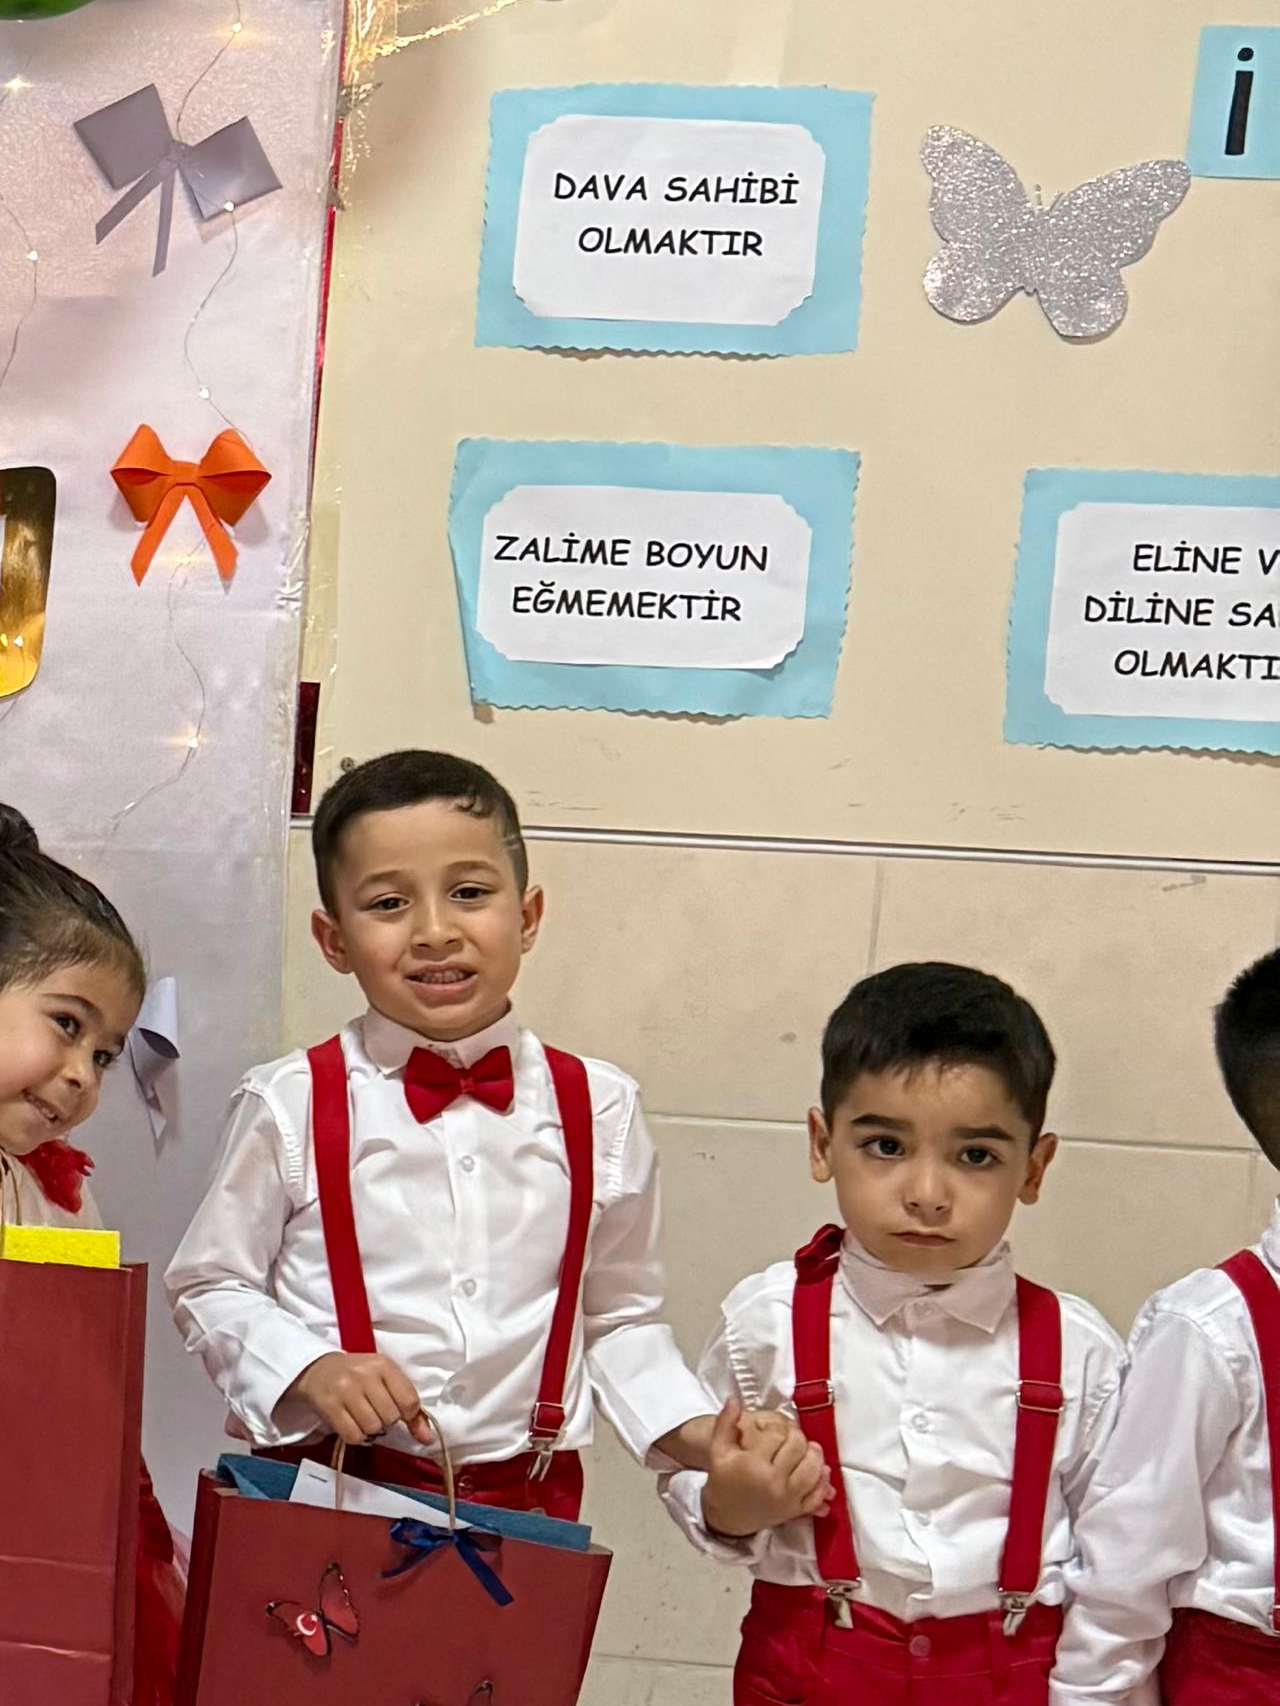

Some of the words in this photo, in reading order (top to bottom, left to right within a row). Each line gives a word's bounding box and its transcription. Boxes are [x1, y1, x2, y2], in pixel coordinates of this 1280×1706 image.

[553, 171, 649, 203] DAVA
[663, 170, 802, 206] SAHİBİ
[577, 226, 764, 258] OLMAKTIR
[493, 531, 633, 568] ZALİME
[645, 539, 769, 573] BOYUN
[1132, 540, 1243, 575] ELİNE
[511, 580, 743, 624] EĞMEMEKTİR
[1083, 590, 1216, 627] DİLİNE
[1227, 601, 1280, 629] SA
